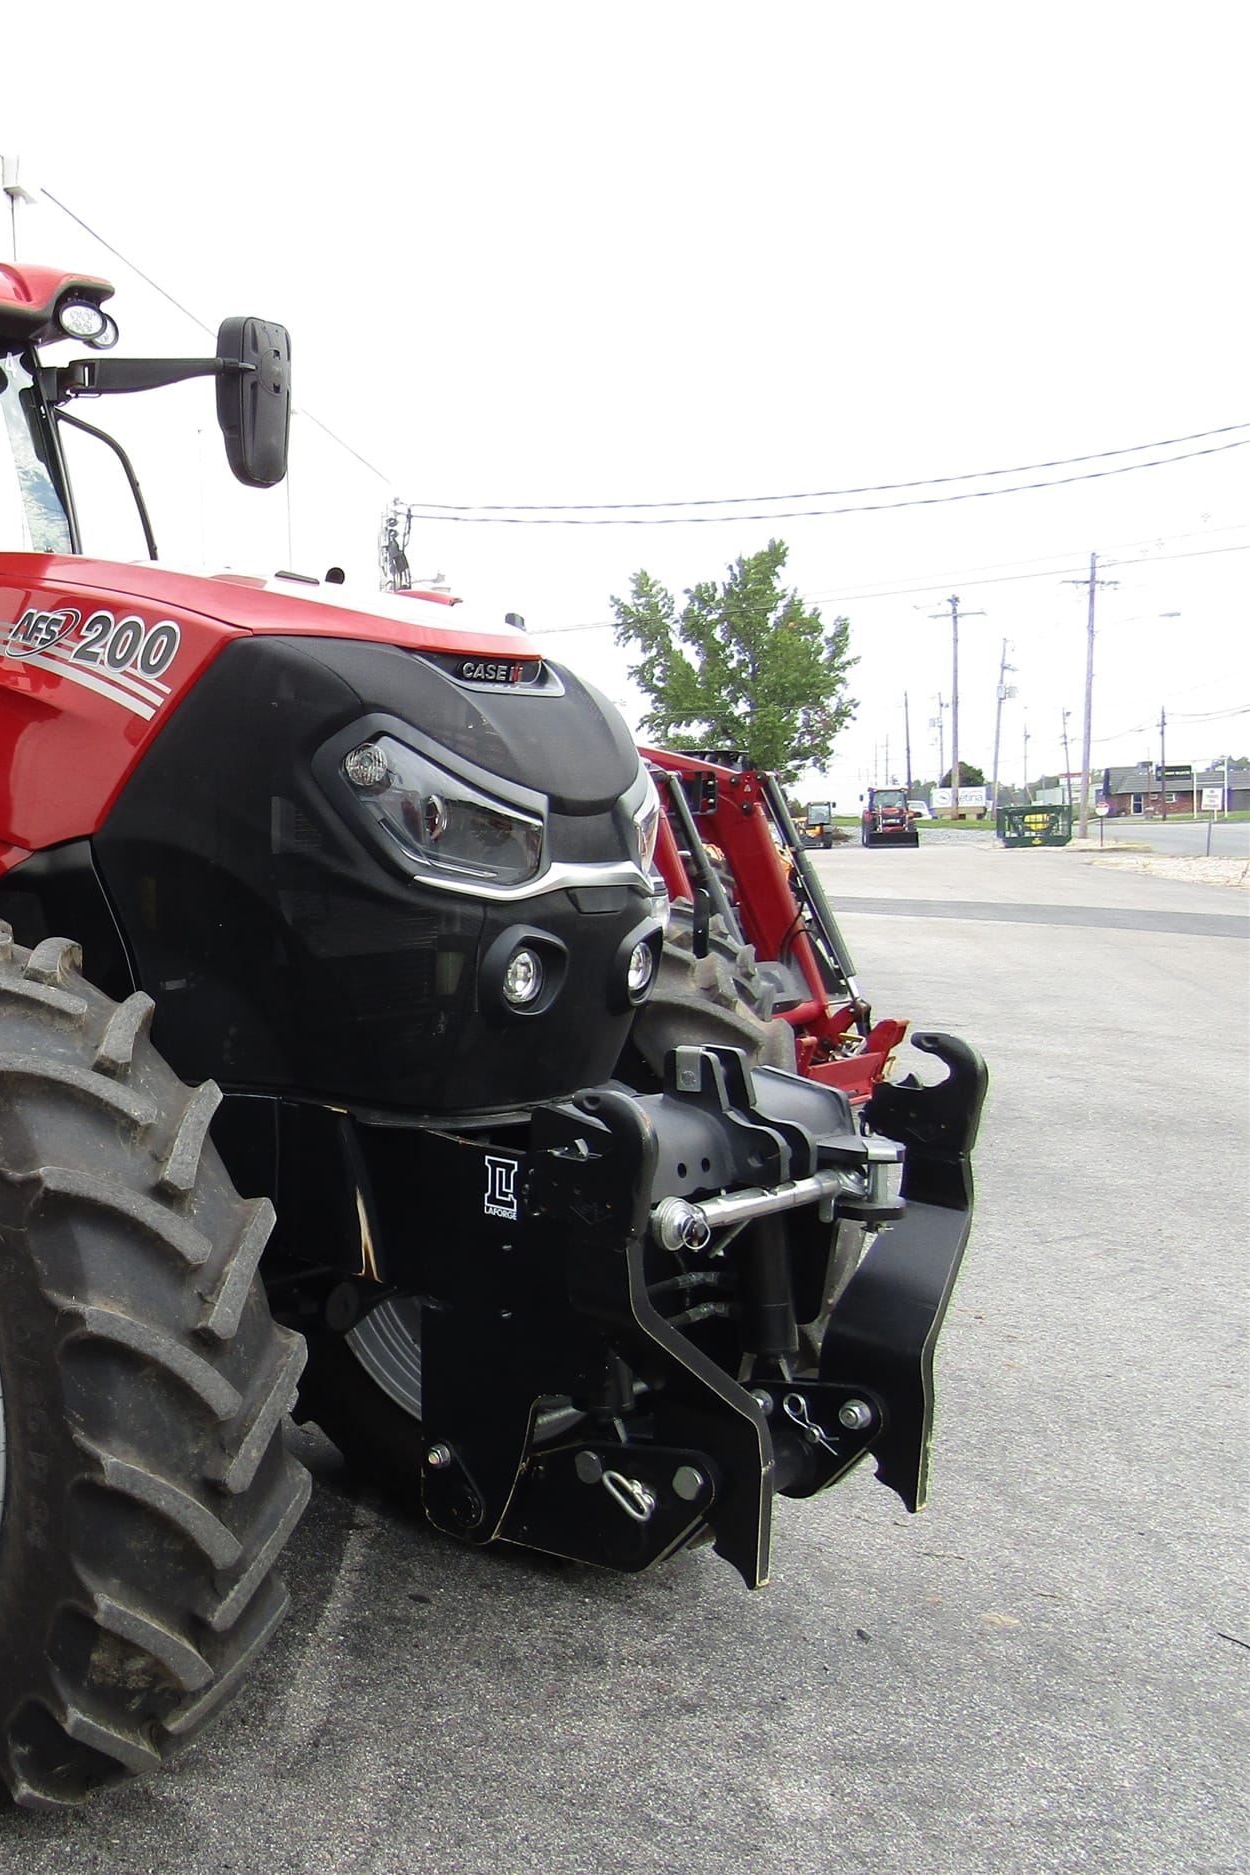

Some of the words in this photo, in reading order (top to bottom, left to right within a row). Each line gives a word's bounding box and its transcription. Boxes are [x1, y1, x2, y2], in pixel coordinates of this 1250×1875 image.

[10, 608, 67, 647] AFS
[70, 610, 181, 680] 200
[462, 662, 507, 681] CASE
[484, 1206, 517, 1220] LAFORGE
